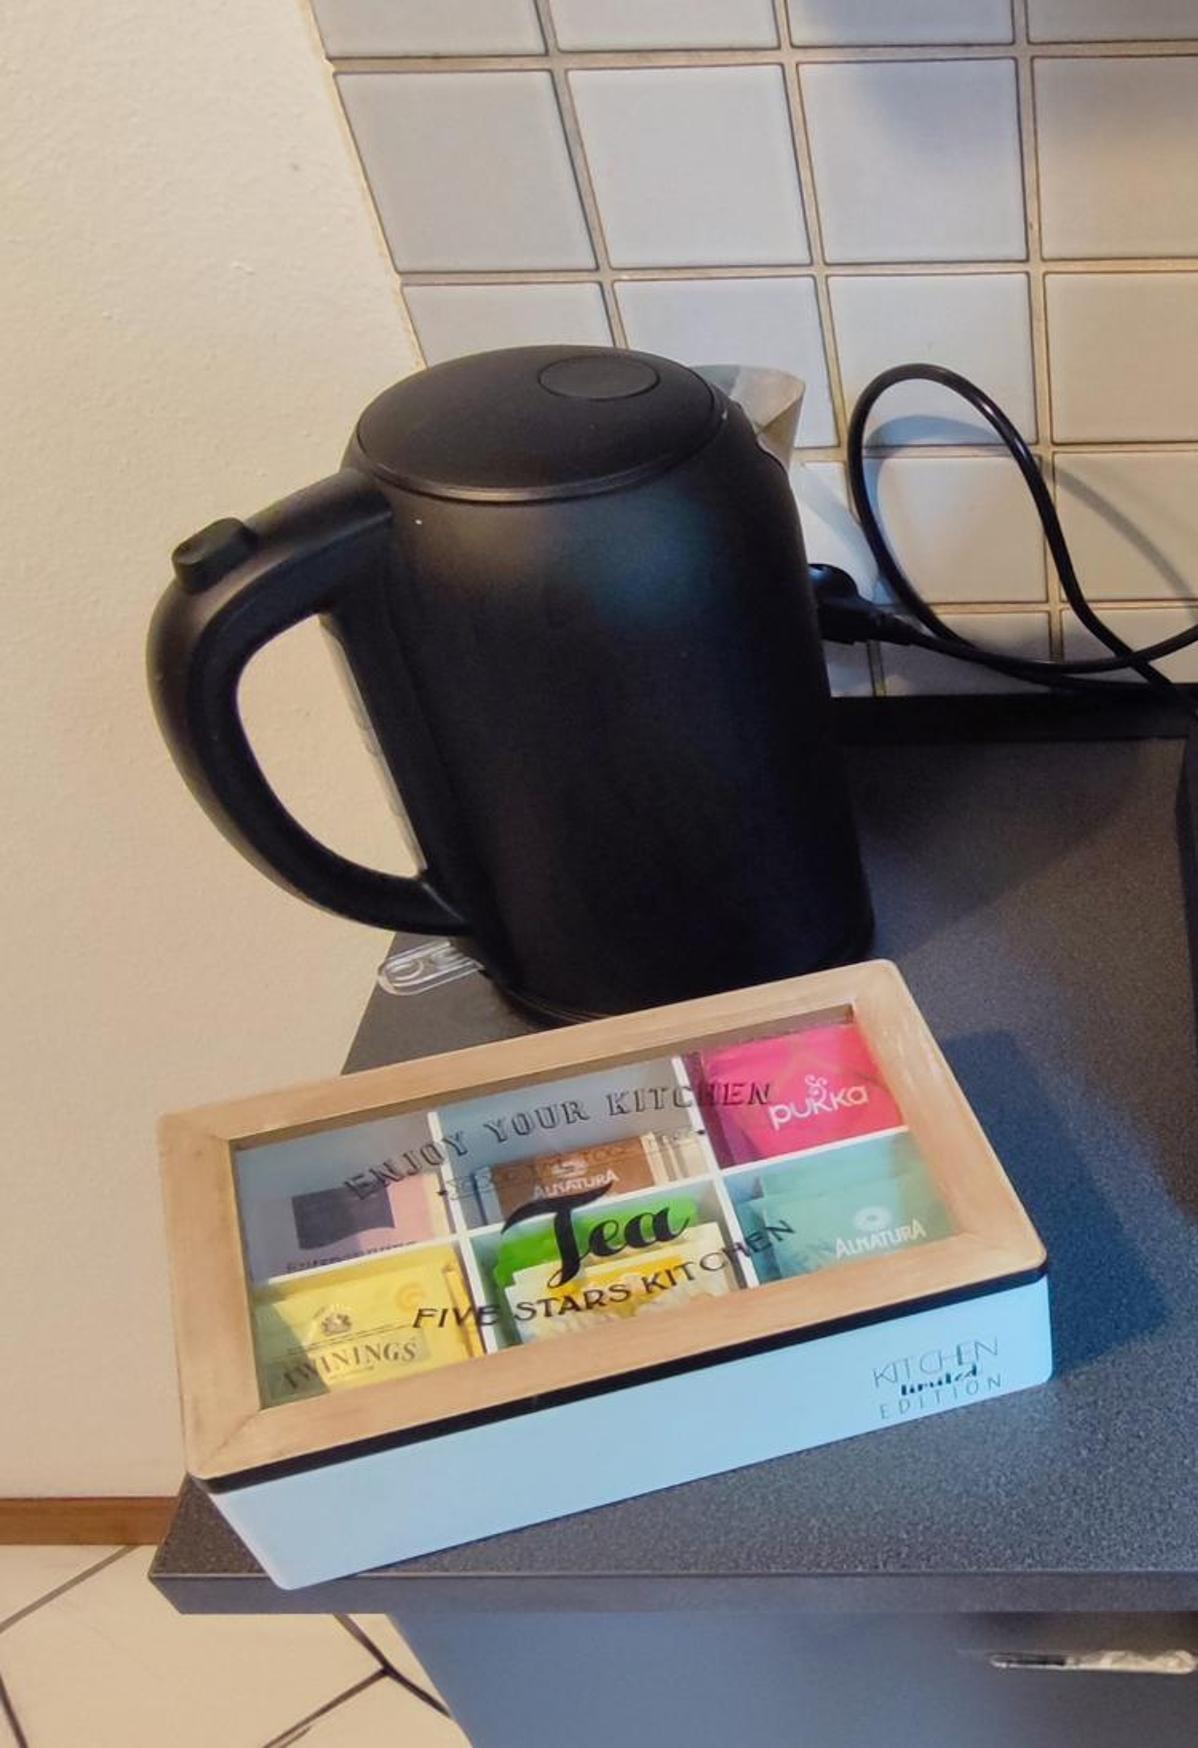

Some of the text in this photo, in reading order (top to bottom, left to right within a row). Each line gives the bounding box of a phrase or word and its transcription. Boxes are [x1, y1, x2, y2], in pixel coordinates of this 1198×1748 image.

[345, 1081, 772, 1200] ENJOY YOUR KITCHEN
[412, 1219, 796, 1329] FIVE STARS KITCHEN
[501, 1182, 691, 1289] Tea
[283, 1341, 417, 1390] TWININGS
[873, 1336, 999, 1388] KITCHEN
[880, 1373, 1002, 1420] EDITION
